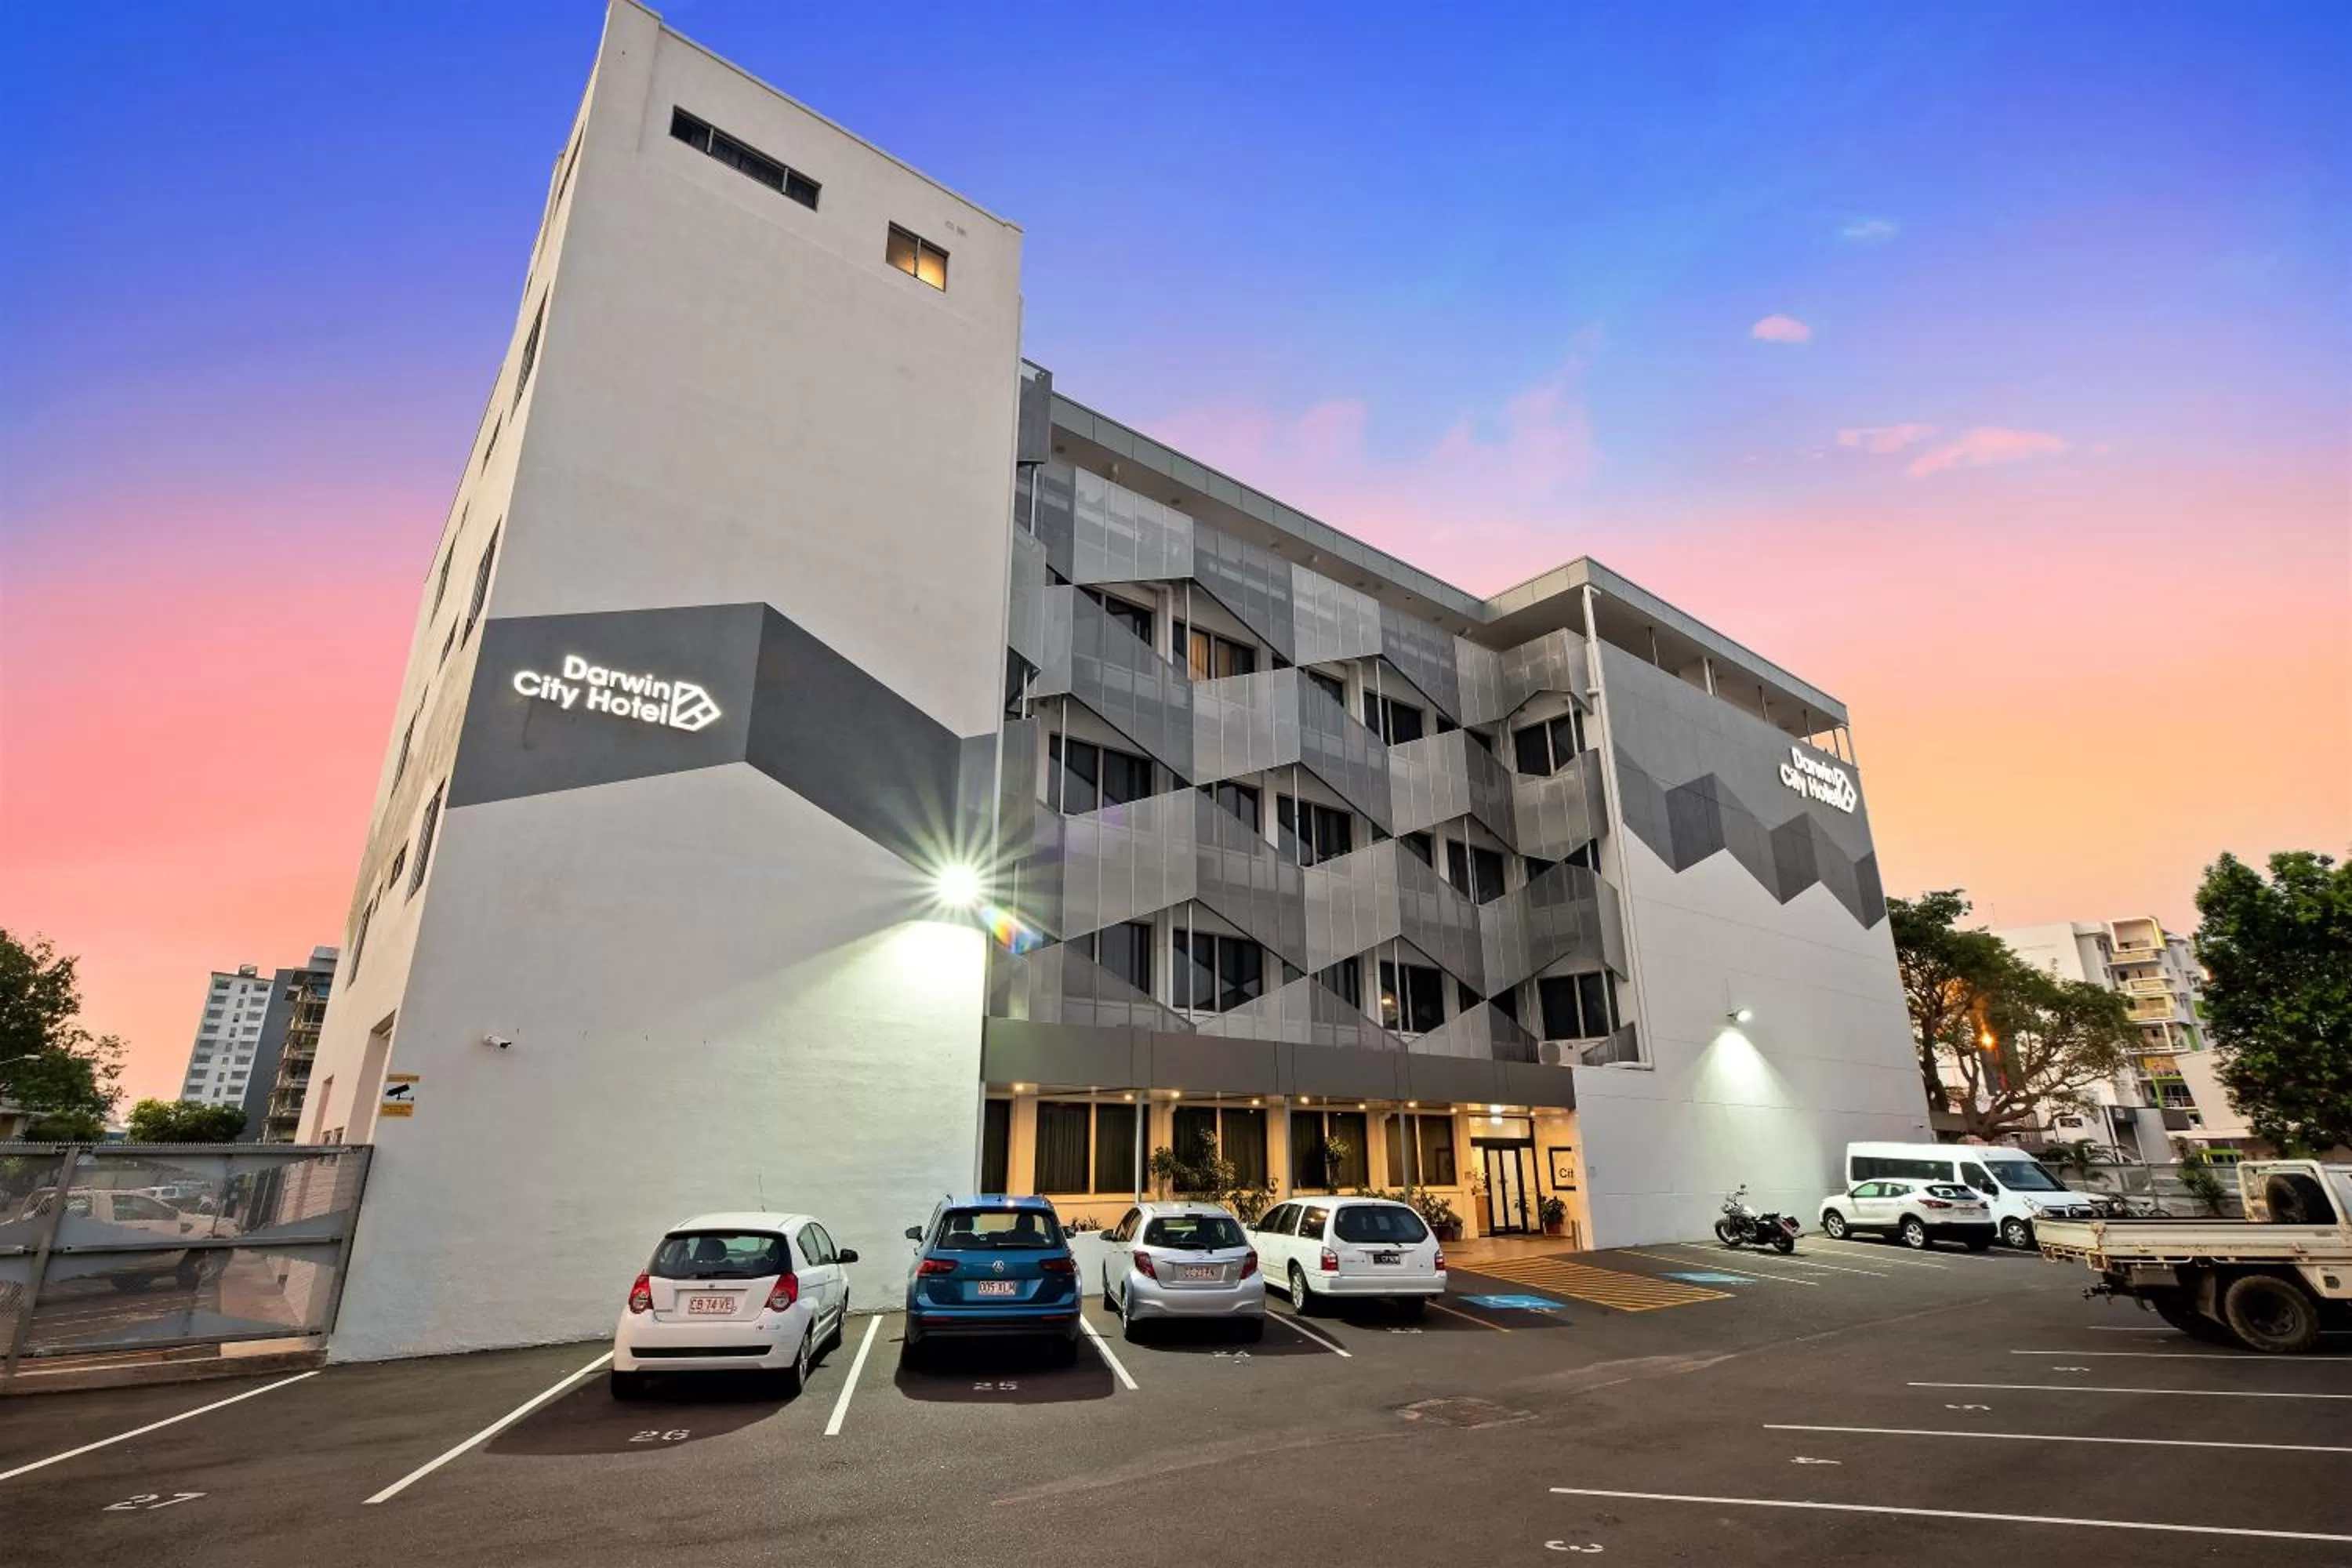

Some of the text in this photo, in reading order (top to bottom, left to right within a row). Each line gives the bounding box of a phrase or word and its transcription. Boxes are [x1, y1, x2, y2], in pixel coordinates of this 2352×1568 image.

[563, 654, 670, 701] Darwin
[514, 670, 668, 725] City Hotel
[1791, 746, 1835, 784] Darwin
[1780, 763, 1842, 808] City Hotel
[972, 1381, 1018, 1391] 25
[627, 1428, 691, 1443] 26
[102, 1492, 209, 1512] 27
